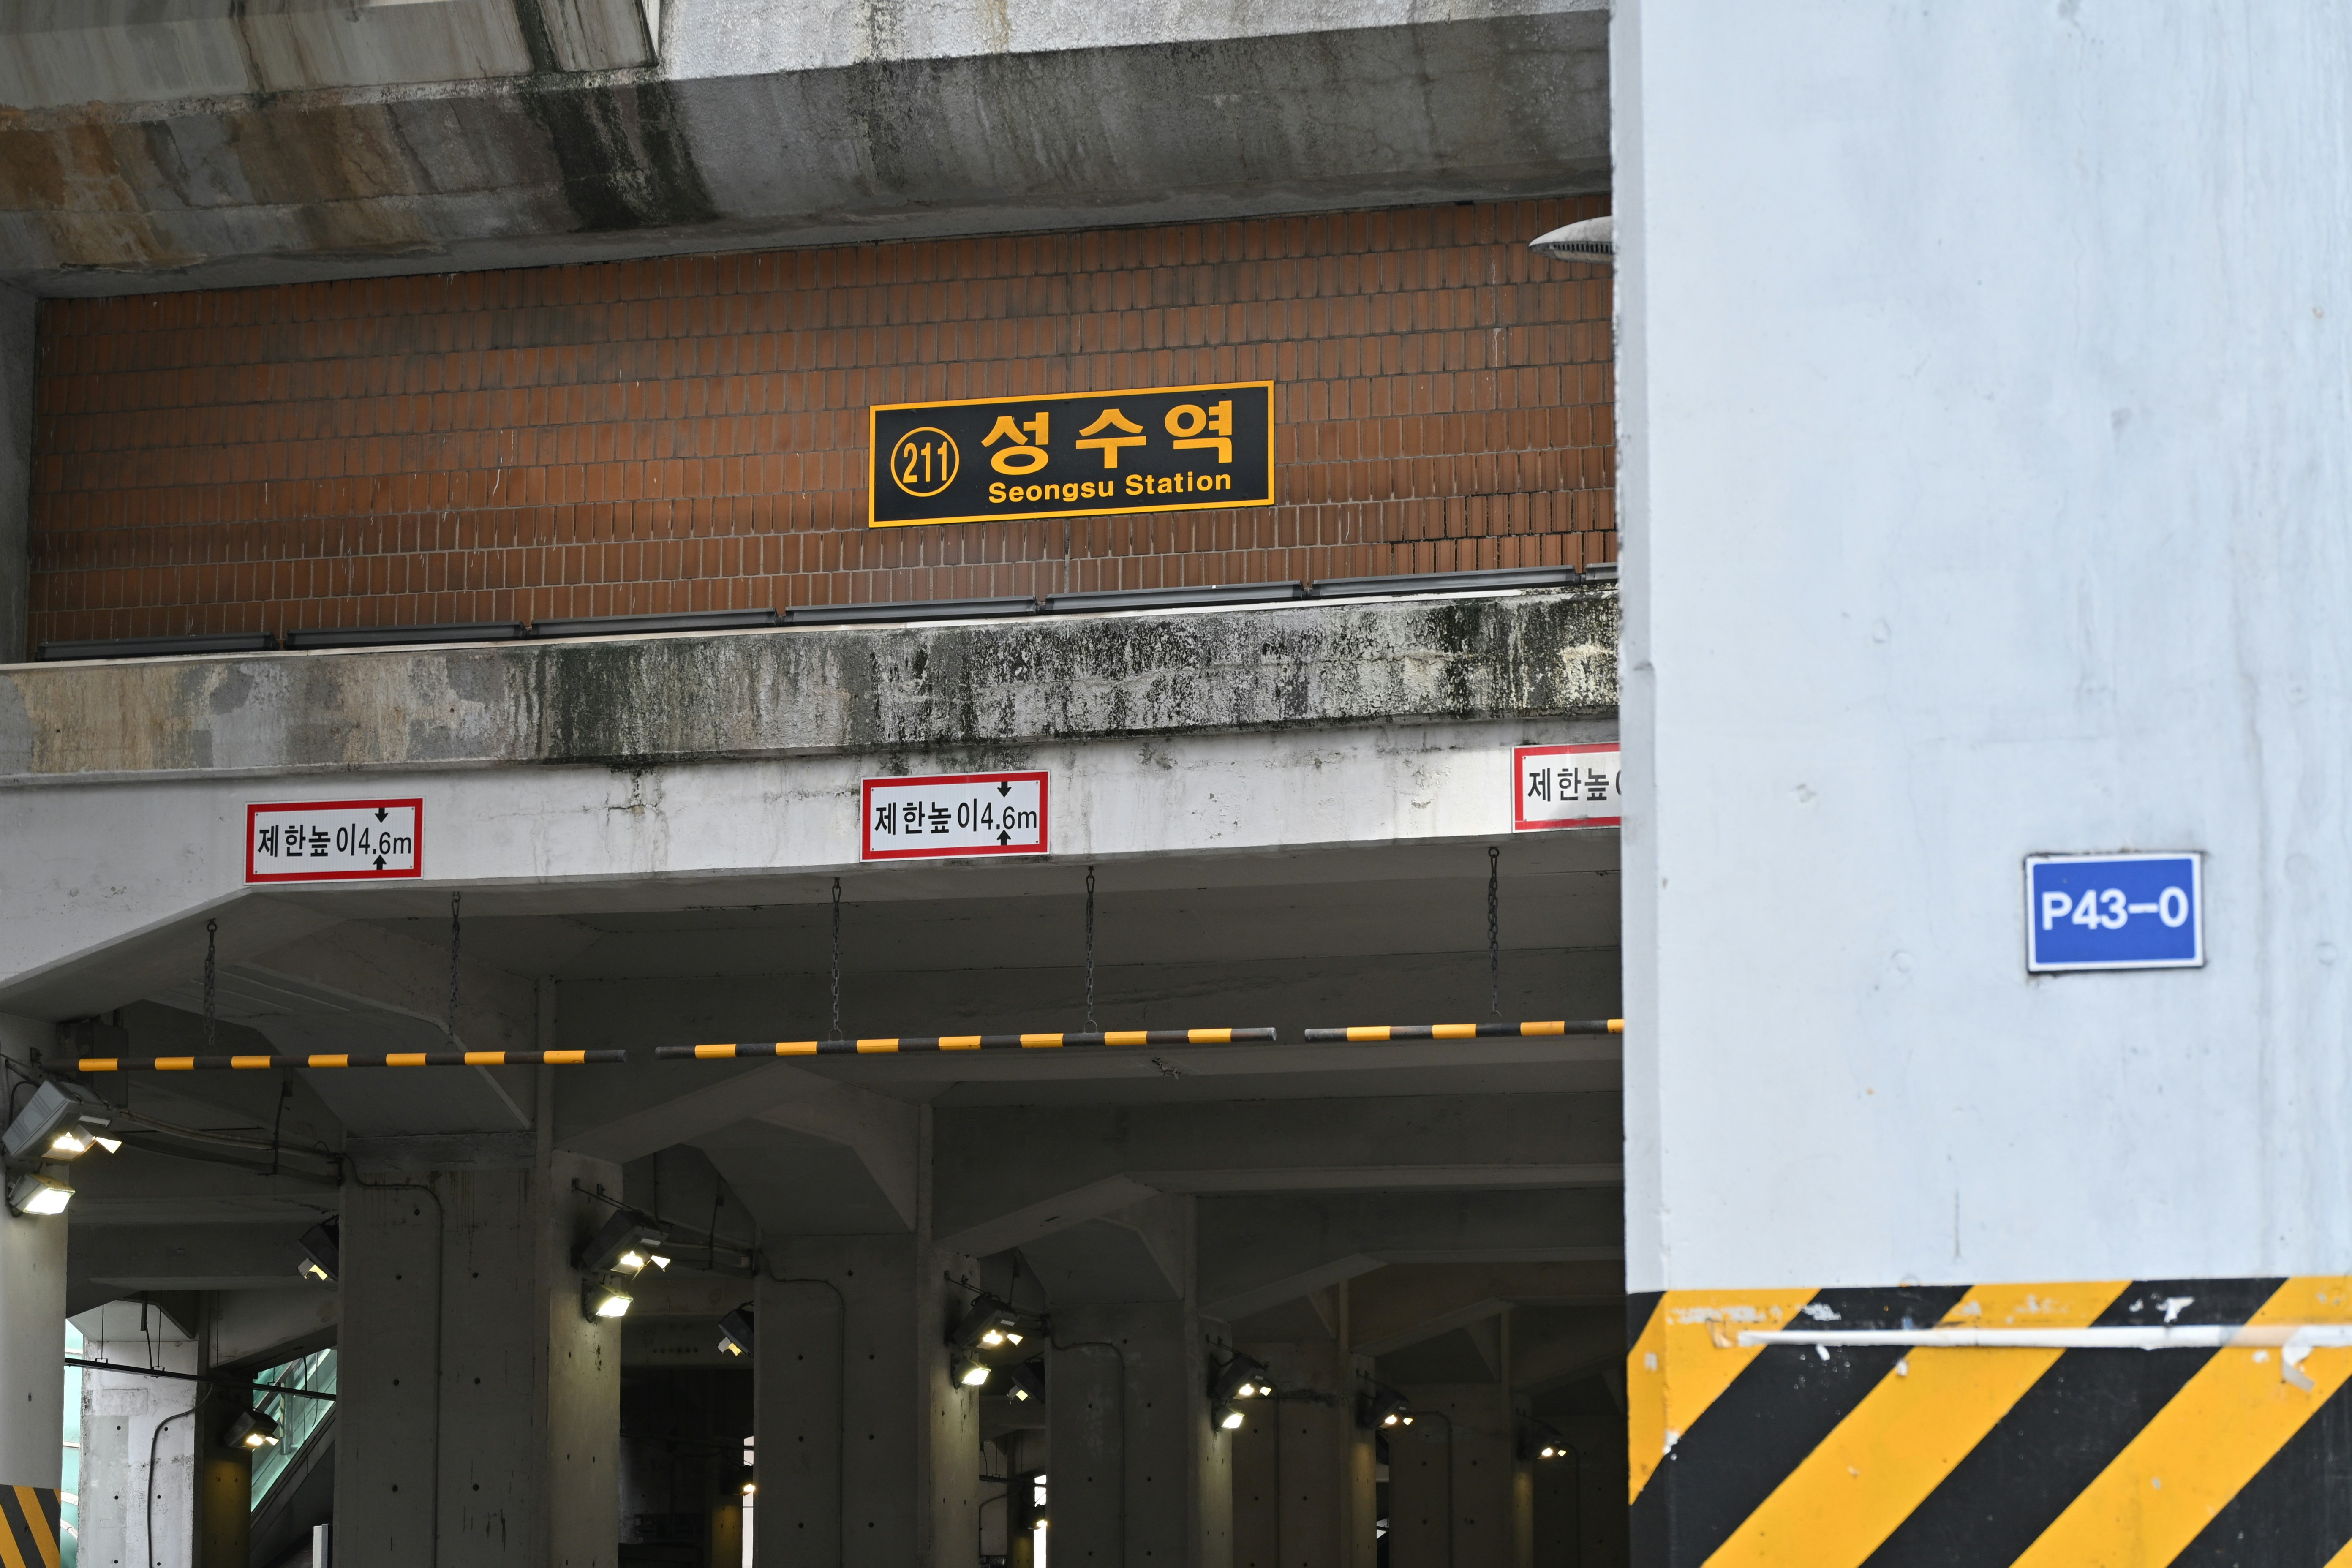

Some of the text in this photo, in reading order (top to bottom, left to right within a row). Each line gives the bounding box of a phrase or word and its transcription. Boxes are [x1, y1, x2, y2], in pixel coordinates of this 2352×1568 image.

[981, 400, 1232, 475] 성수역
[903, 441, 948, 483] 211
[988, 471, 1231, 504] Seongsu Station
[1527, 767, 1622, 802] 제한높
[2042, 886, 2189, 930] P43-0
